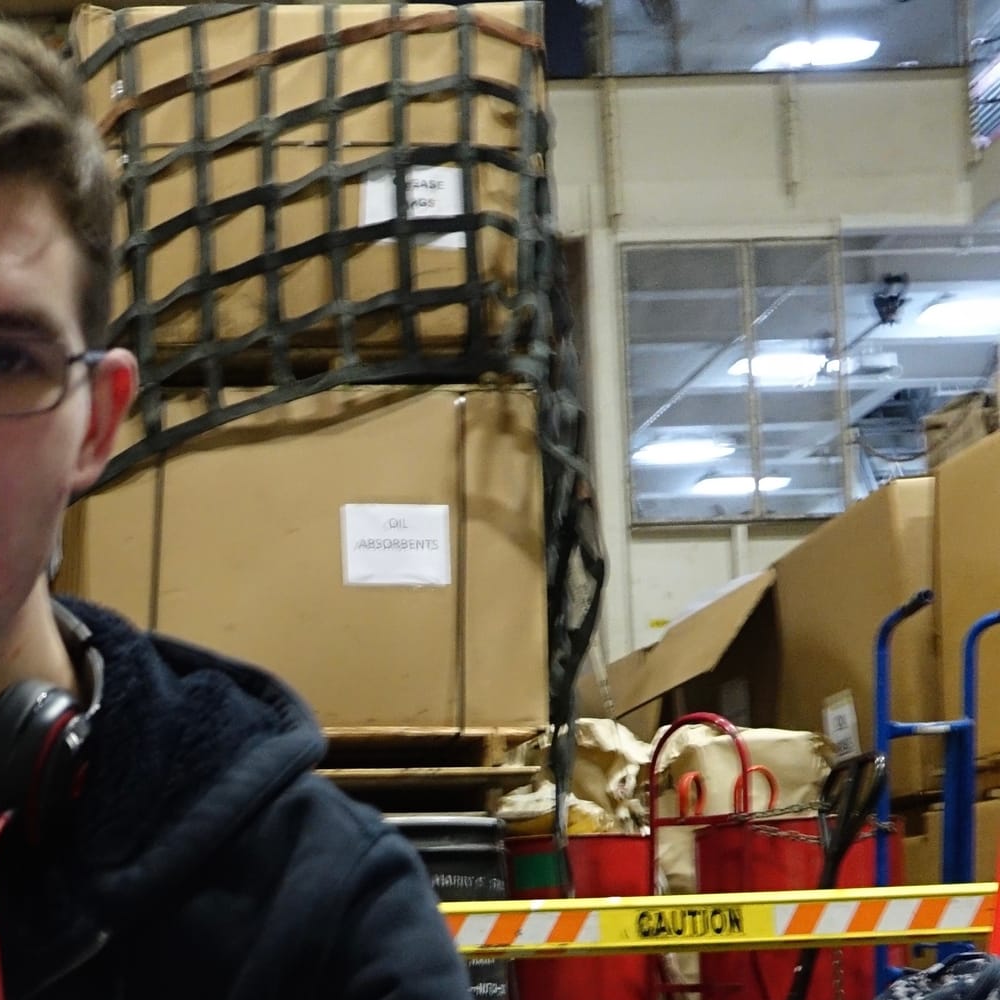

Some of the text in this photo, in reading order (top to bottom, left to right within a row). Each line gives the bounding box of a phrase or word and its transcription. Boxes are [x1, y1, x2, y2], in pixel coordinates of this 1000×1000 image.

[388, 517, 409, 529] OIL
[356, 537, 440, 551] ABSORBENTS
[637, 908, 744, 938] CAUTION
